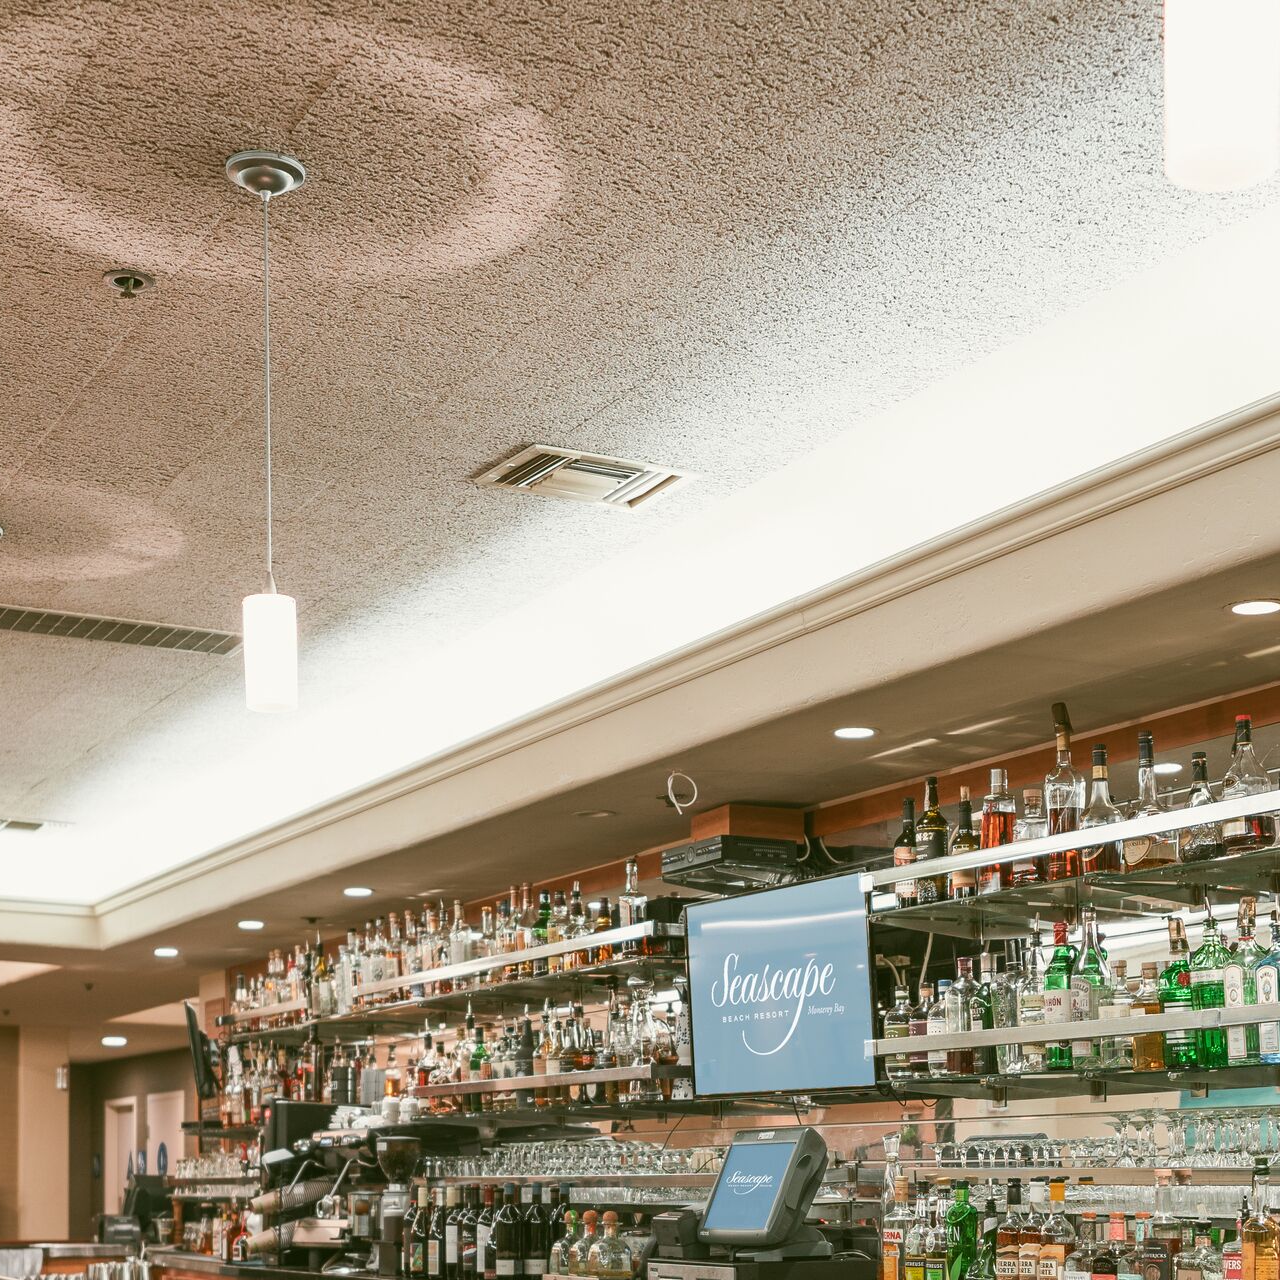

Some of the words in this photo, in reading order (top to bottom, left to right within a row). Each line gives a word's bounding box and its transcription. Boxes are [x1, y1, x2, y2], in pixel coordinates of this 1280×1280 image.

[711, 953, 837, 1055] Seascape
[722, 1013, 751, 1023] BEACH
[754, 1010, 790, 1020] RESORT
[726, 1170, 774, 1195] Seascape
